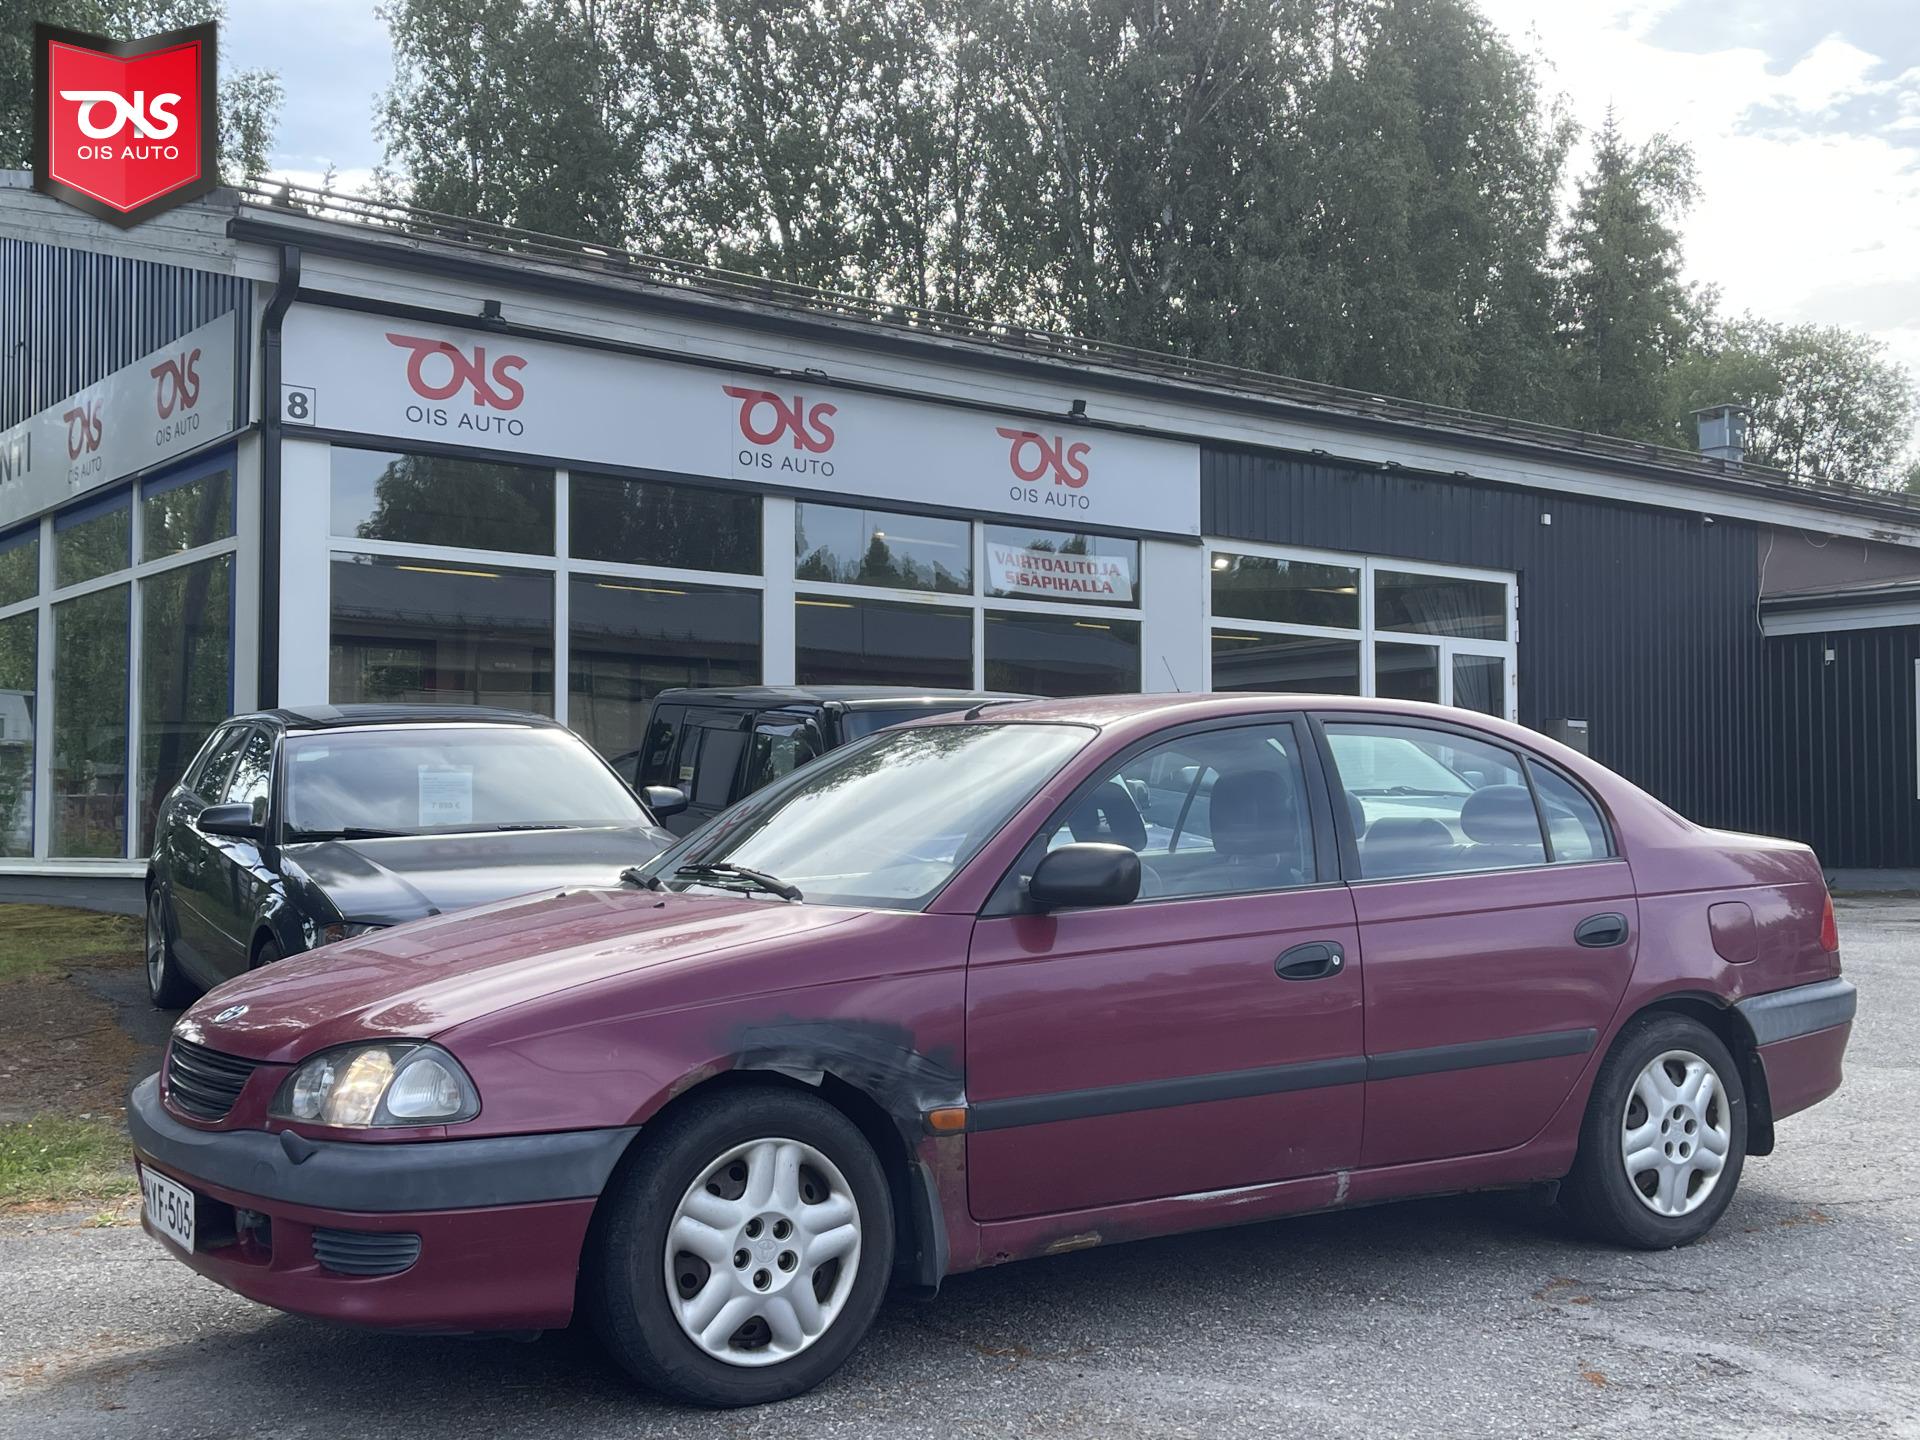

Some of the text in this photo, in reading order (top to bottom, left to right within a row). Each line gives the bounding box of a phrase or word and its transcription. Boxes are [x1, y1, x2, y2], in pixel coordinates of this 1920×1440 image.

[385, 332, 528, 411] OIS
[287, 391, 309, 419] 8
[721, 384, 838, 454] OIS
[156, 427, 172, 447] OIS
[173, 413, 200, 438] AUTO
[405, 405, 524, 436] OIS AUTO
[81, 456, 103, 478] AUTO
[738, 449, 835, 477] OIS AUTO
[996, 426, 1092, 489] OIS
[1009, 486, 1091, 510] OIS AUTO
[994, 550, 1121, 577] VAIHTOAUTOJA
[1004, 570, 1115, 594] SISÄPIHALLA
